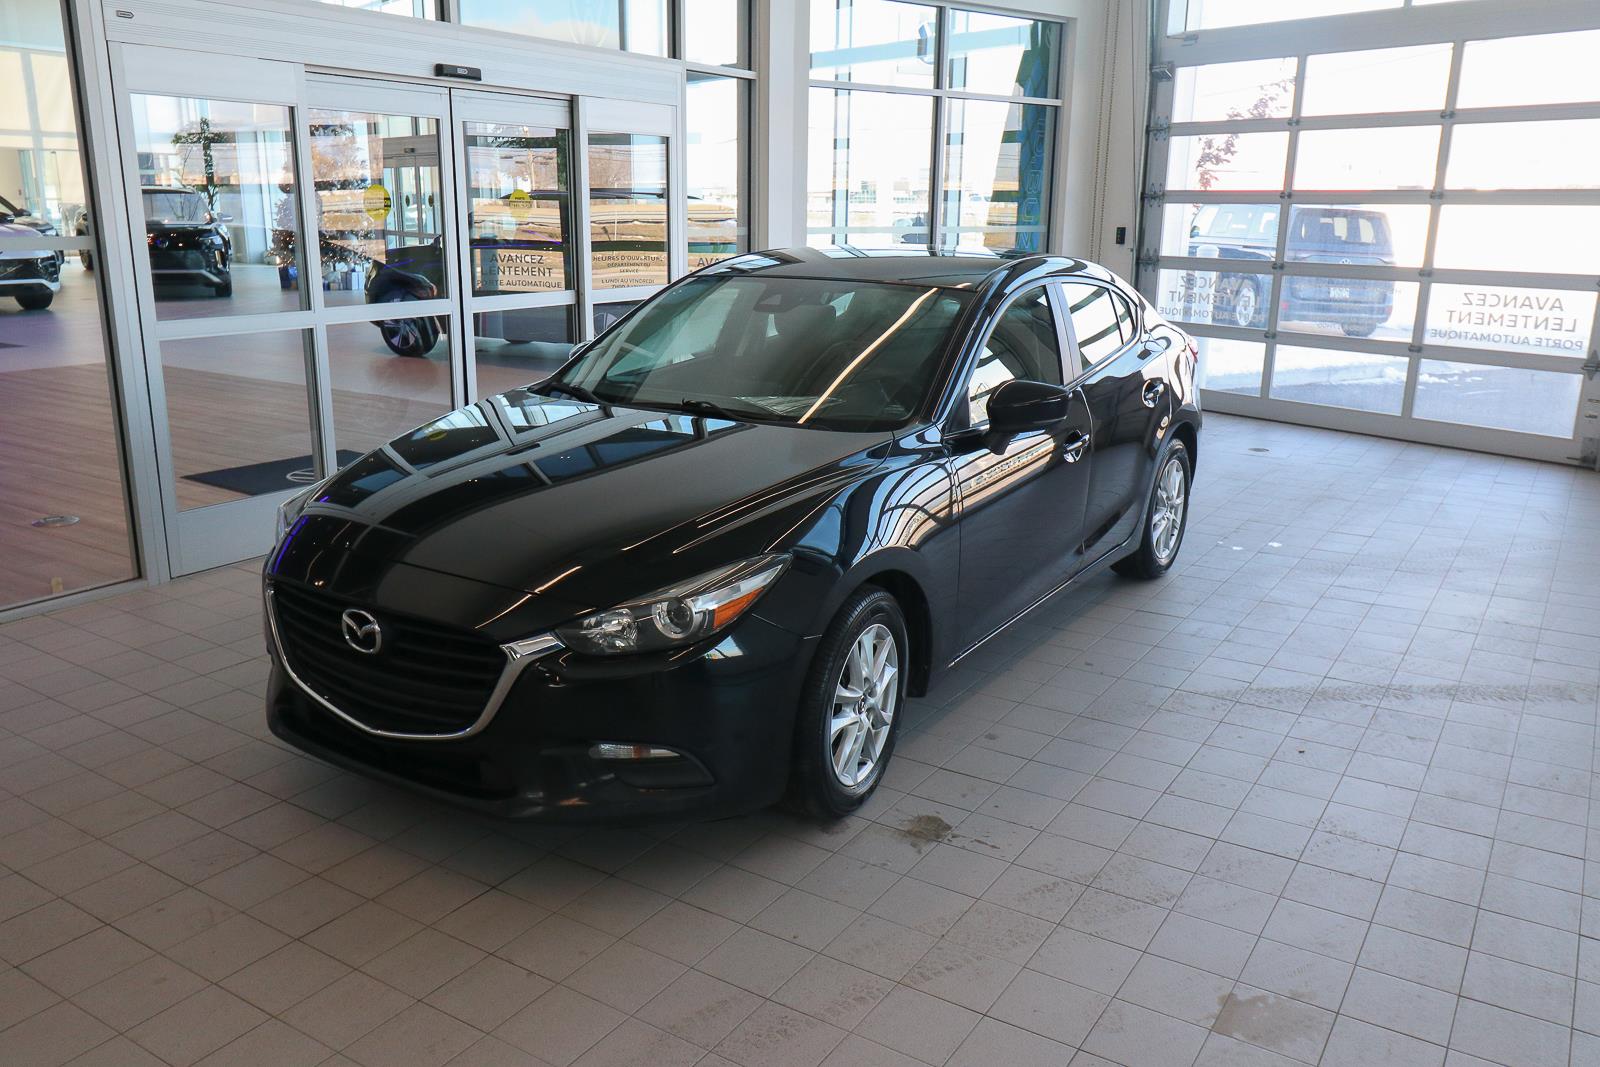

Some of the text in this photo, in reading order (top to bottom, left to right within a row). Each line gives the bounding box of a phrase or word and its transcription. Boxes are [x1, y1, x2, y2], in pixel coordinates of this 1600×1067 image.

[490, 253, 545, 265] AVANCEZ
[481, 266, 553, 277] LENTEMENT
[505, 279, 563, 289] AUTOMATIQUE
